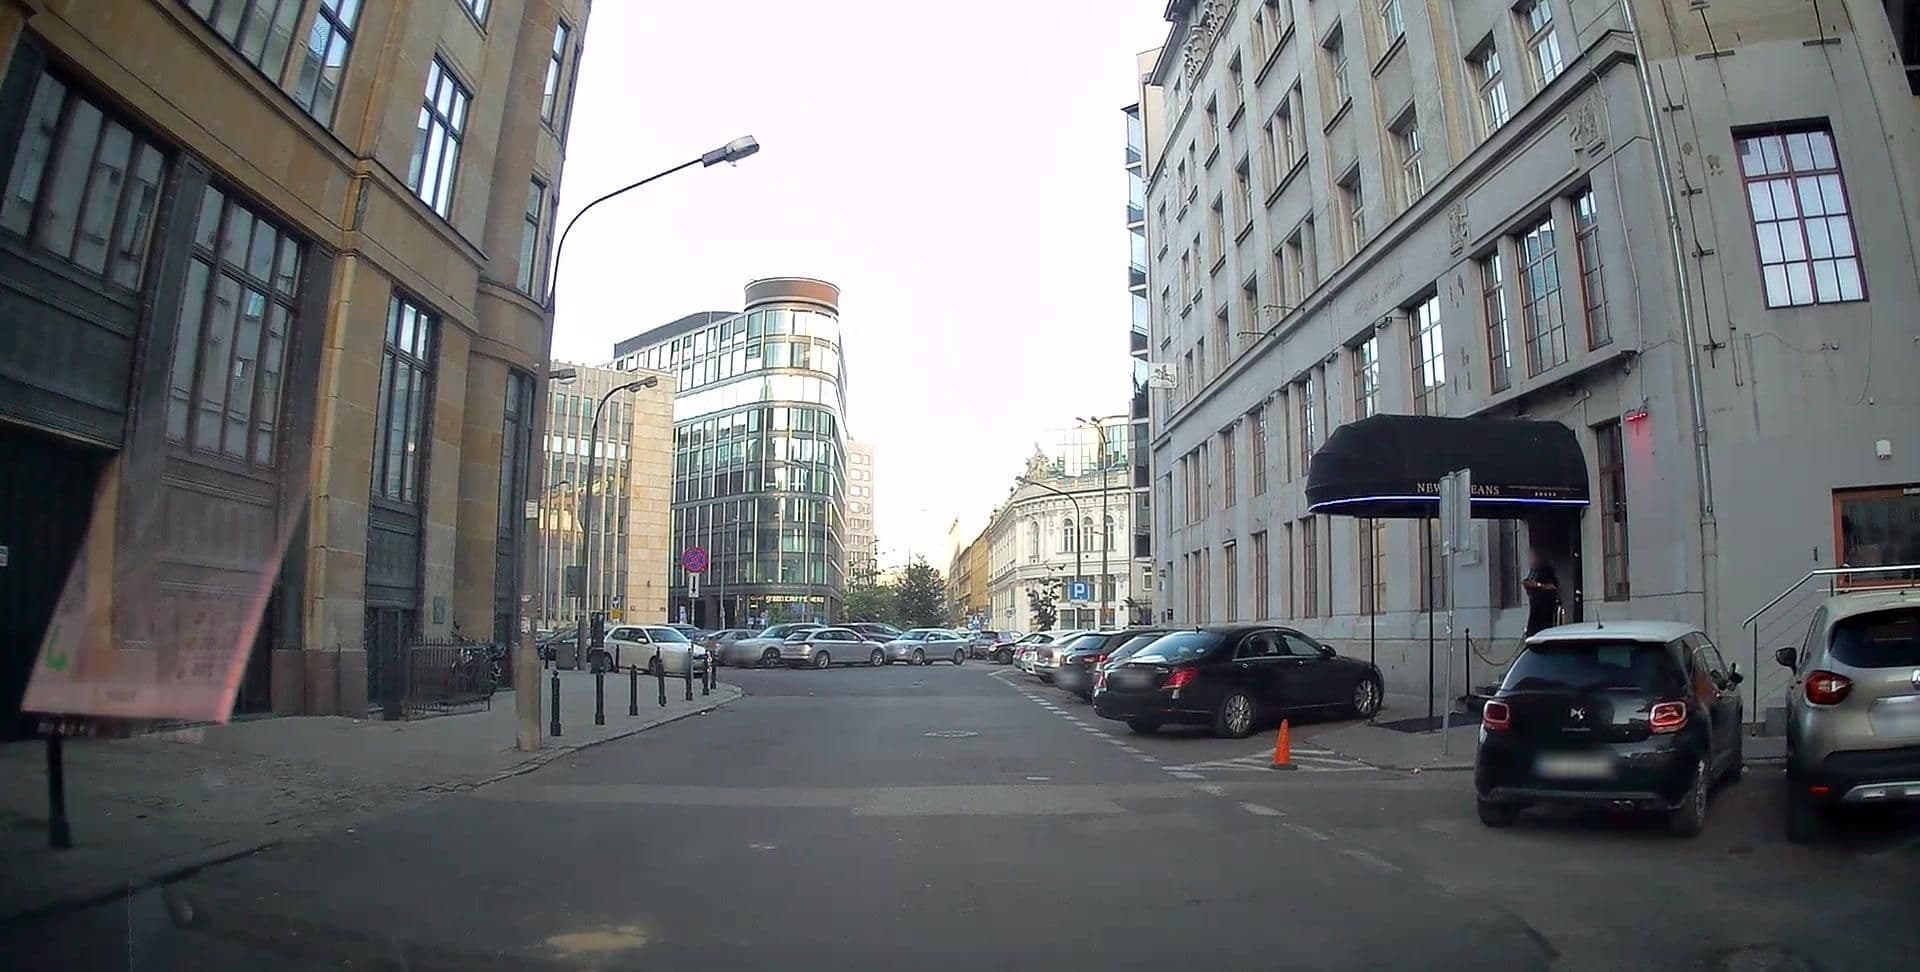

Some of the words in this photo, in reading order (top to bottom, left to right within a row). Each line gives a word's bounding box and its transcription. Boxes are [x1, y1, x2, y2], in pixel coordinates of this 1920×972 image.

[1417, 482, 1440, 494] NEW
[1471, 484, 1500, 496] EANS
[1074, 583, 1085, 598] P
